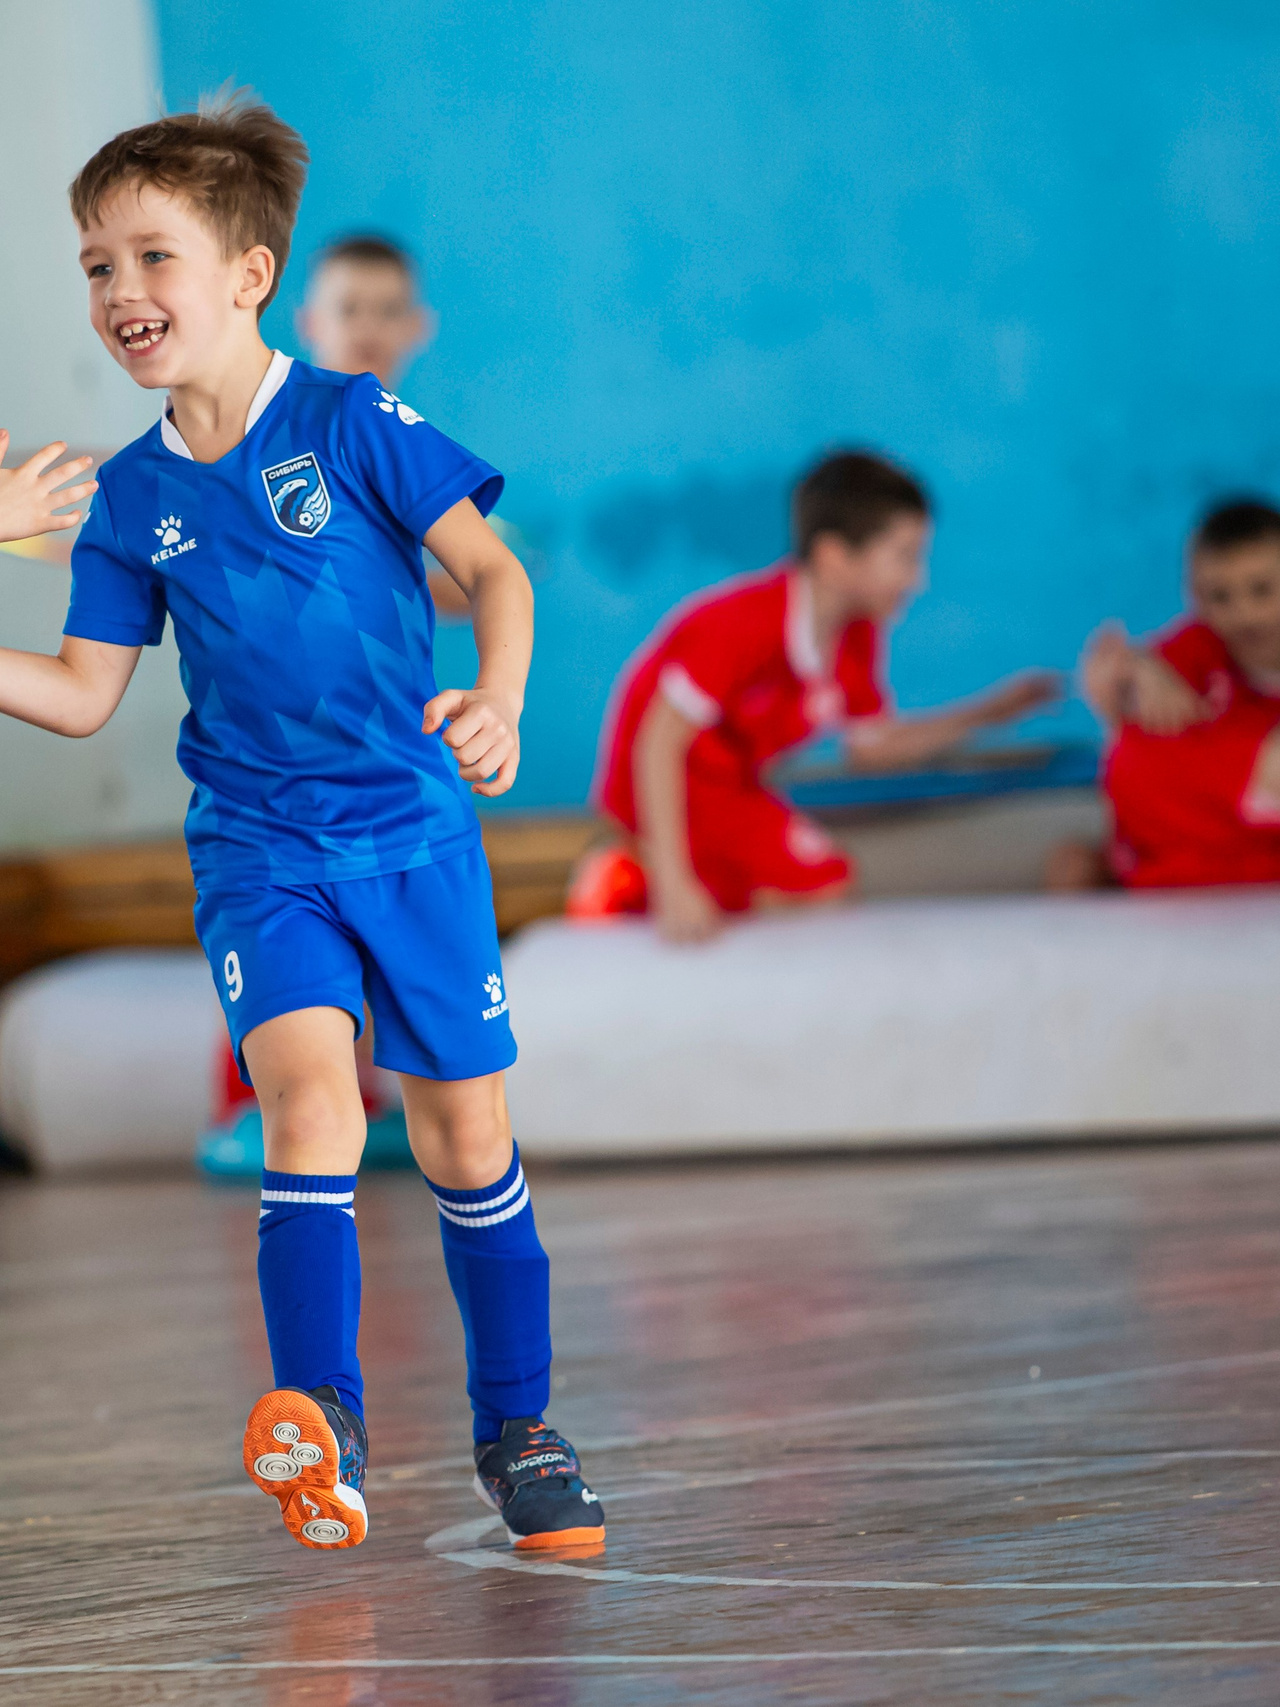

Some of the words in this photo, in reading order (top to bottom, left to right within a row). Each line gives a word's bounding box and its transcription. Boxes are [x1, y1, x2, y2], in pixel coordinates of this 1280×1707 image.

[268, 459, 312, 480] СИБИРЬ
[151, 538, 198, 565] KELME
[224, 951, 243, 1002] 9
